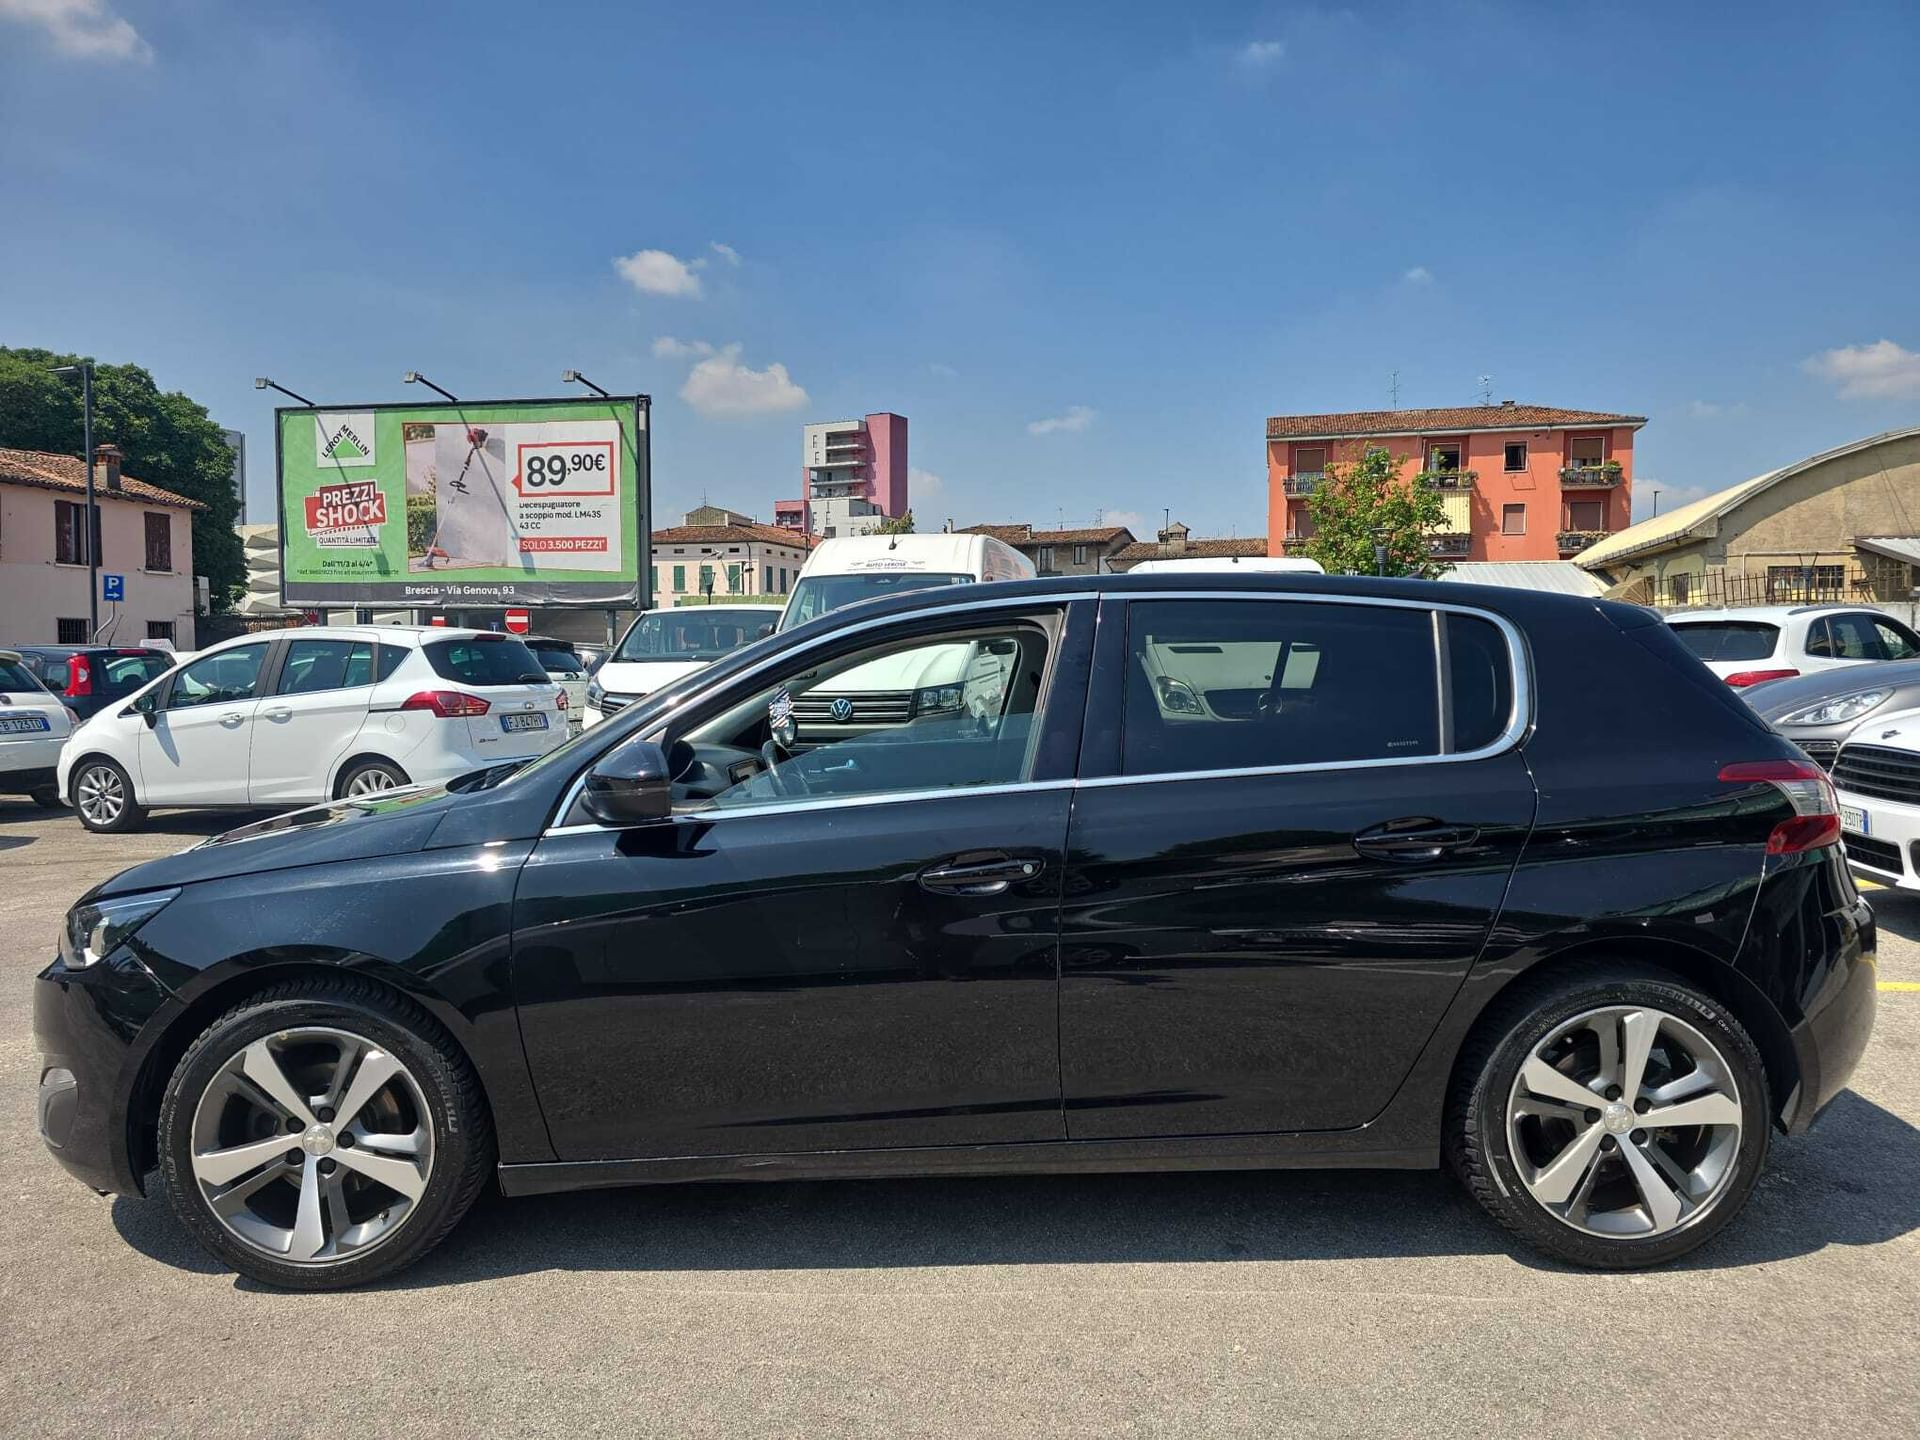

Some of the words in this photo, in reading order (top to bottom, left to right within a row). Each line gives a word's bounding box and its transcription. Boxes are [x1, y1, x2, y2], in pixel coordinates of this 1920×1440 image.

[321, 431, 344, 458] LEROY
[340, 424, 370, 456] MERLIN
[526, 453, 606, 488] 89,90€
[322, 489, 375, 507] PREZZI
[315, 499, 384, 528] SHOCK
[525, 511, 554, 520] scoppio
[555, 511, 574, 519] mod.
[519, 522, 529, 530] 43
[530, 521, 541, 530] CC
[318, 536, 350, 544] QUANTITÀ
[350, 536, 377, 544] LIMITATE
[522, 540, 546, 550] SOLO
[547, 540, 573, 550] 3.500
[108, 577, 120, 589] P
[405, 585, 439, 595] Brescia
[446, 585, 462, 595] Via
[463, 585, 501, 596] Genova,
[502, 585, 515, 595] 93
